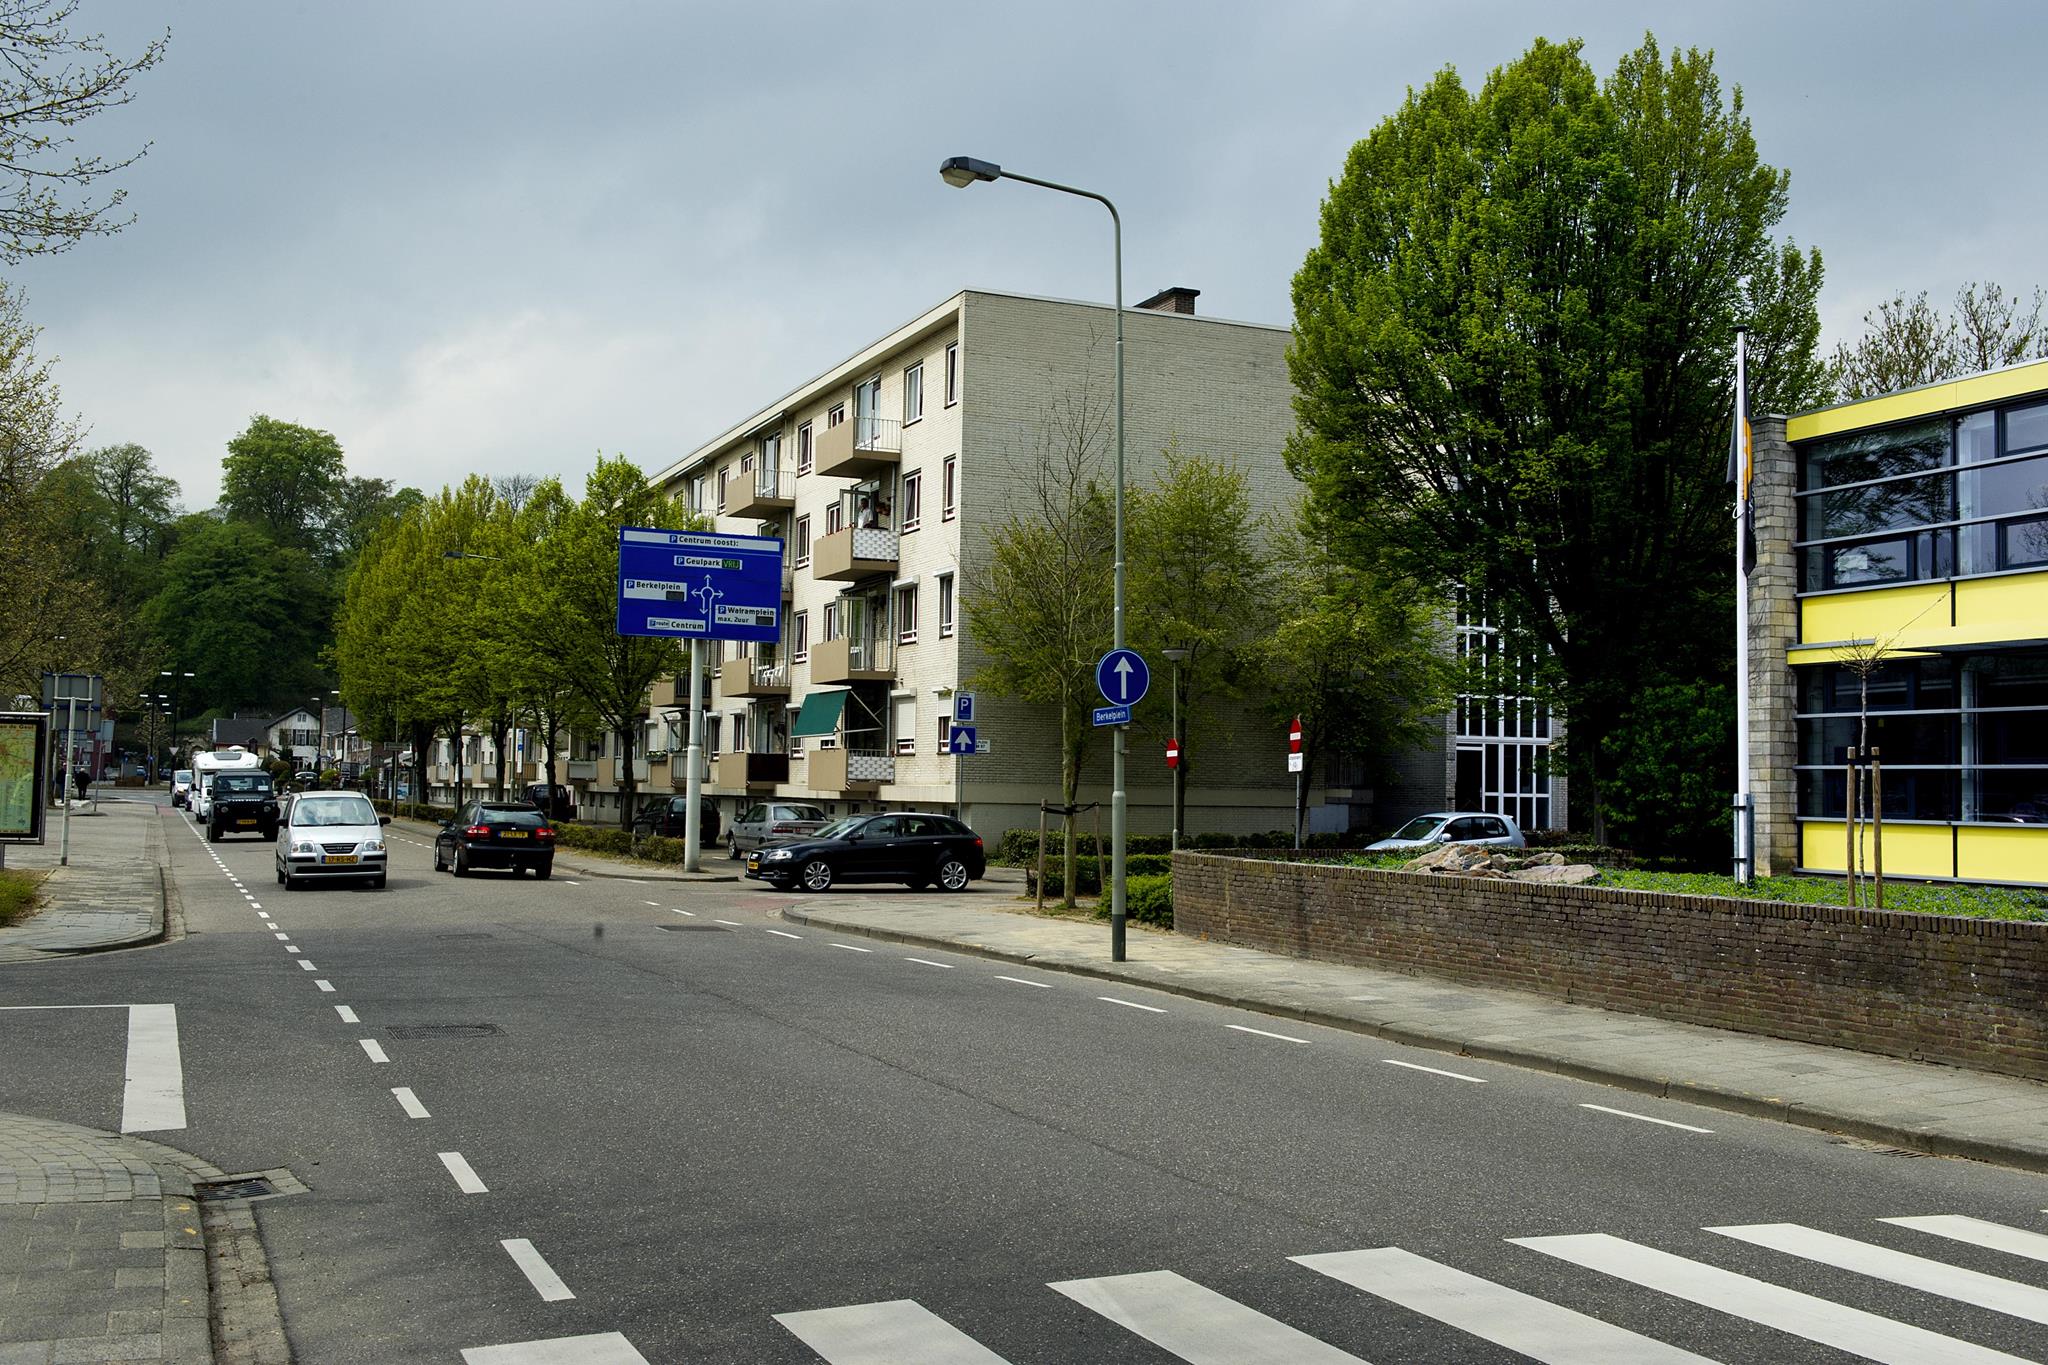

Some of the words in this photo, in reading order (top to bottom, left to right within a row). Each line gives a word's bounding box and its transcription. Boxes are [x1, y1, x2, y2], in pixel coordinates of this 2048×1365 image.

[679, 536, 711, 544] Centrum
[714, 538, 738, 546] (oost):
[686, 558, 720, 566] Geulpark
[636, 582, 680, 590] Berkelplein
[728, 607, 774, 616] Walramplein
[1096, 710, 1126, 721] Berkelplein
